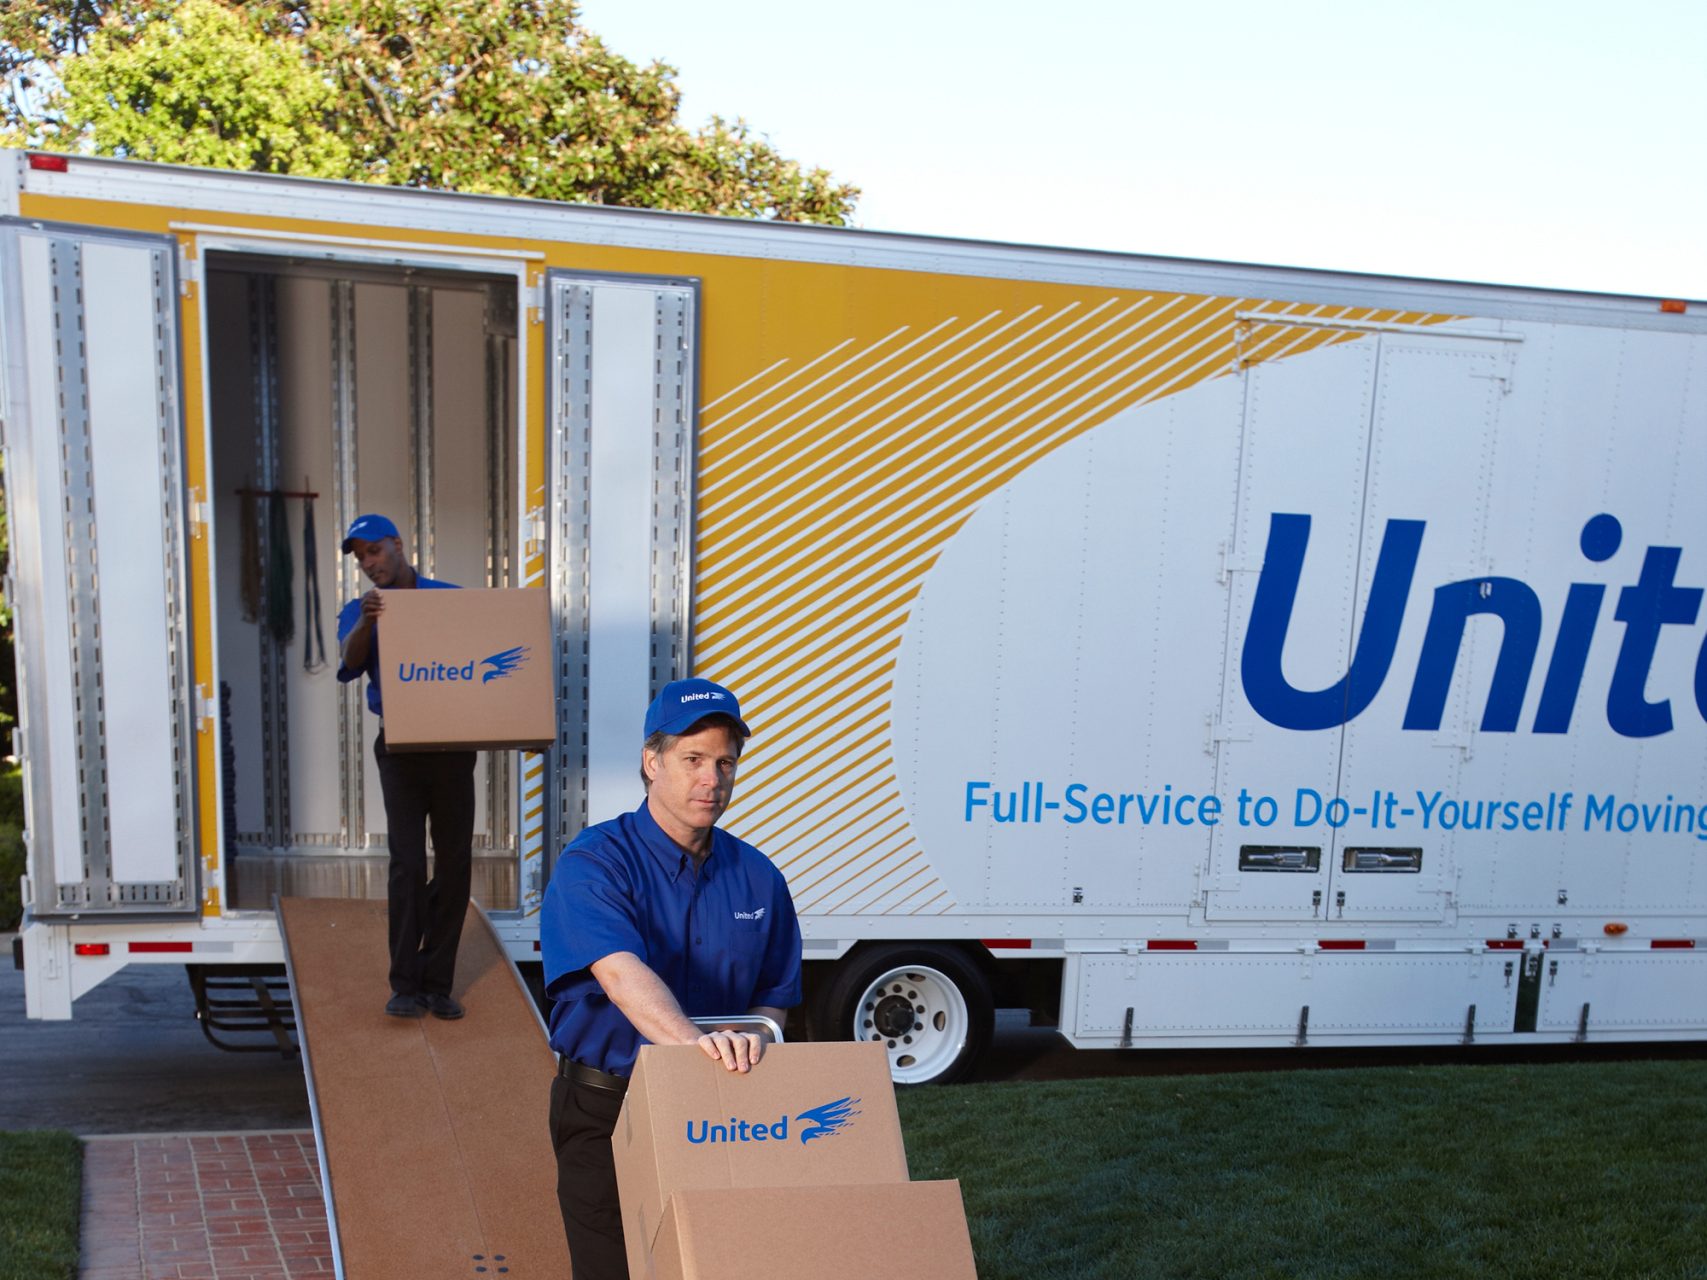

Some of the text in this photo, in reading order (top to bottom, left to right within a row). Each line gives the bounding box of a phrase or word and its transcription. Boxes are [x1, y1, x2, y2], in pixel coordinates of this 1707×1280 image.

[1241, 512, 1707, 738] Unit
[399, 661, 475, 682] United
[681, 692, 710, 703] United
[965, 781, 1222, 827] Full-Service
[1237, 788, 1279, 828] to
[1293, 787, 1574, 832] Do-It-Yourself
[734, 911, 754, 920] United
[687, 1115, 788, 1144] United
